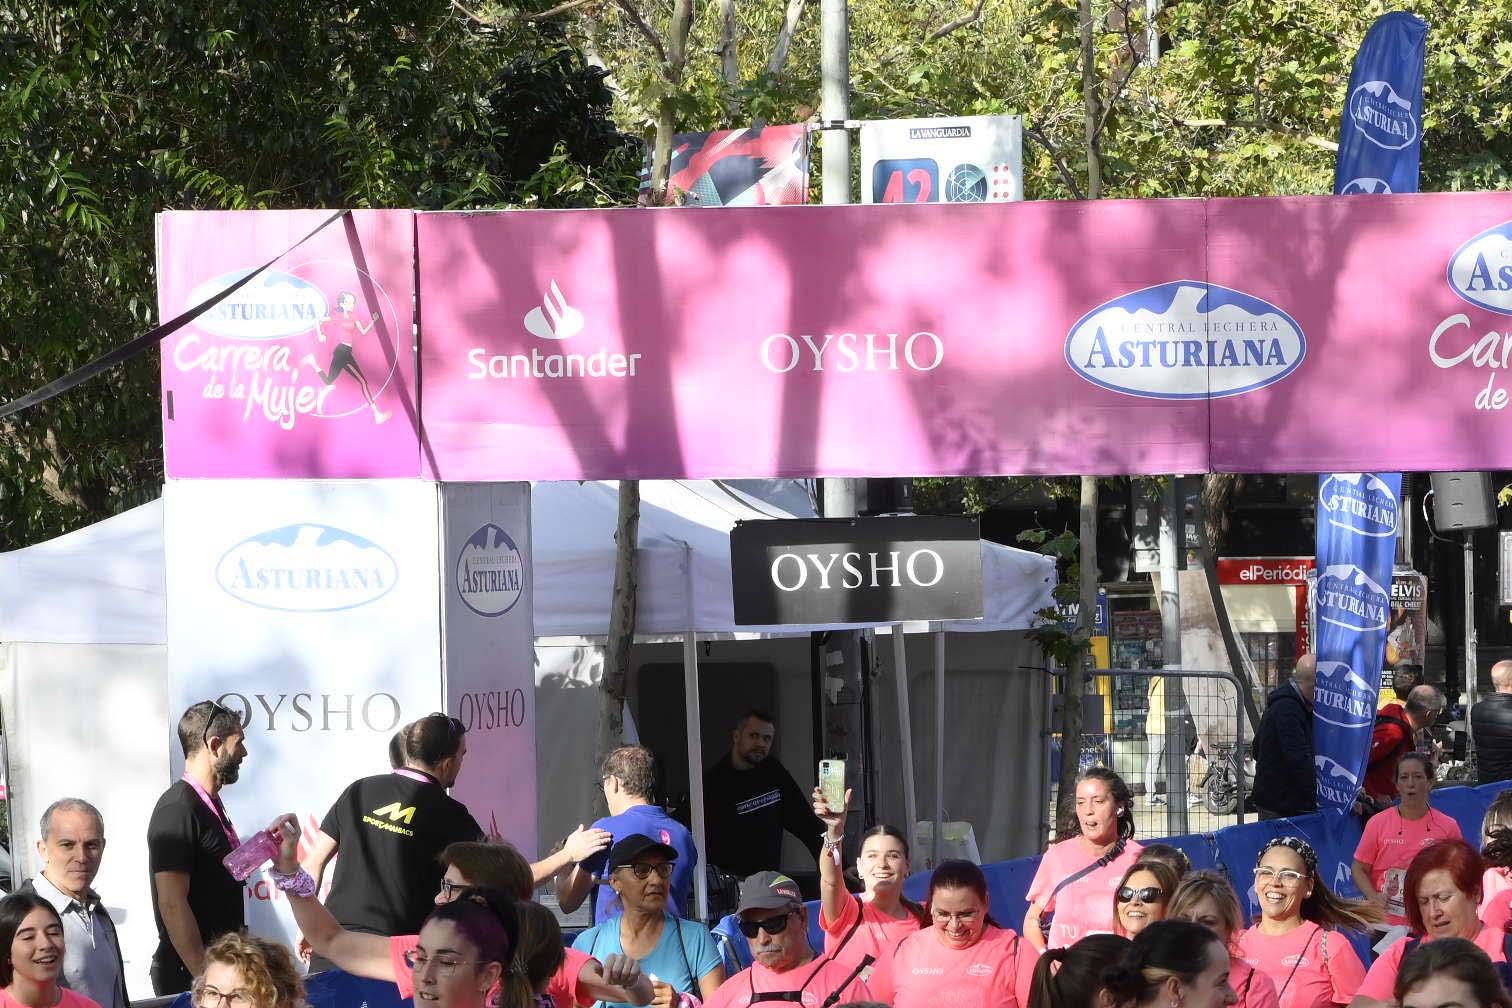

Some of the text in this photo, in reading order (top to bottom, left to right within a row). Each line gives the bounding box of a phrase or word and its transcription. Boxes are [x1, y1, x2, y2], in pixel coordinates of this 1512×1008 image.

[911, 128, 970, 139] LA VANGUARDIA
[1120, 320, 1279, 333] CENTRAL LECHERA
[174, 335, 290, 371] Carrera
[469, 348, 641, 380] Santander
[760, 332, 944, 373] OYSHO
[1085, 328, 1287, 369] ASTURIANA
[203, 368, 336, 430] de la Mujer
[1475, 371, 1509, 410] de
[1328, 494, 1394, 528] STURIANA
[231, 557, 385, 590] ASTURIANA
[462, 566, 520, 594] ASTURIANA
[771, 549, 944, 591] OYSHO
[1391, 585, 1421, 597] ELVIS
[214, 691, 402, 732] OYSHO
[459, 689, 525, 733] OYSHO
